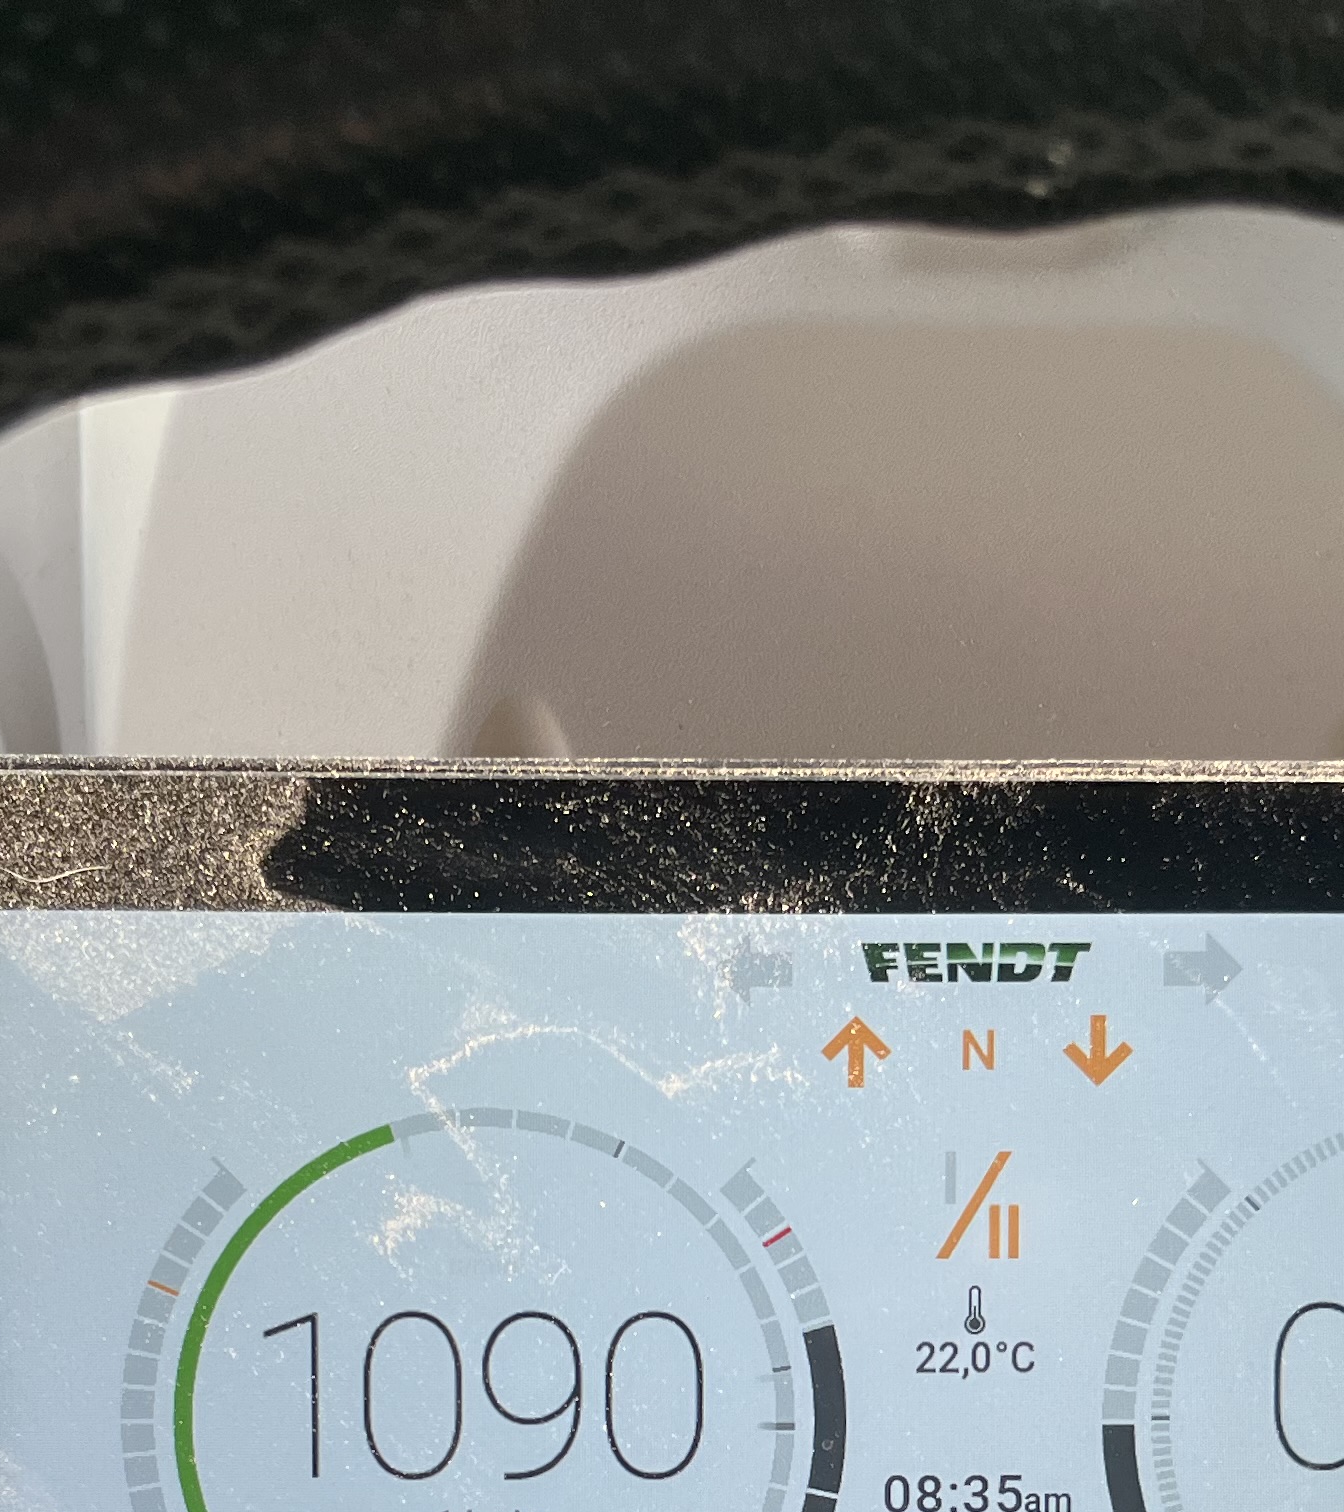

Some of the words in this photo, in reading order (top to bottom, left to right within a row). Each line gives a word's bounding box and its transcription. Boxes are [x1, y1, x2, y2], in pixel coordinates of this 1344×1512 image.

[861, 942, 1092, 983] FENDT
[962, 1029, 995, 1071] N
[914, 1341, 1035, 1380] 22,0°C
[262, 1309, 704, 1482] 1090
